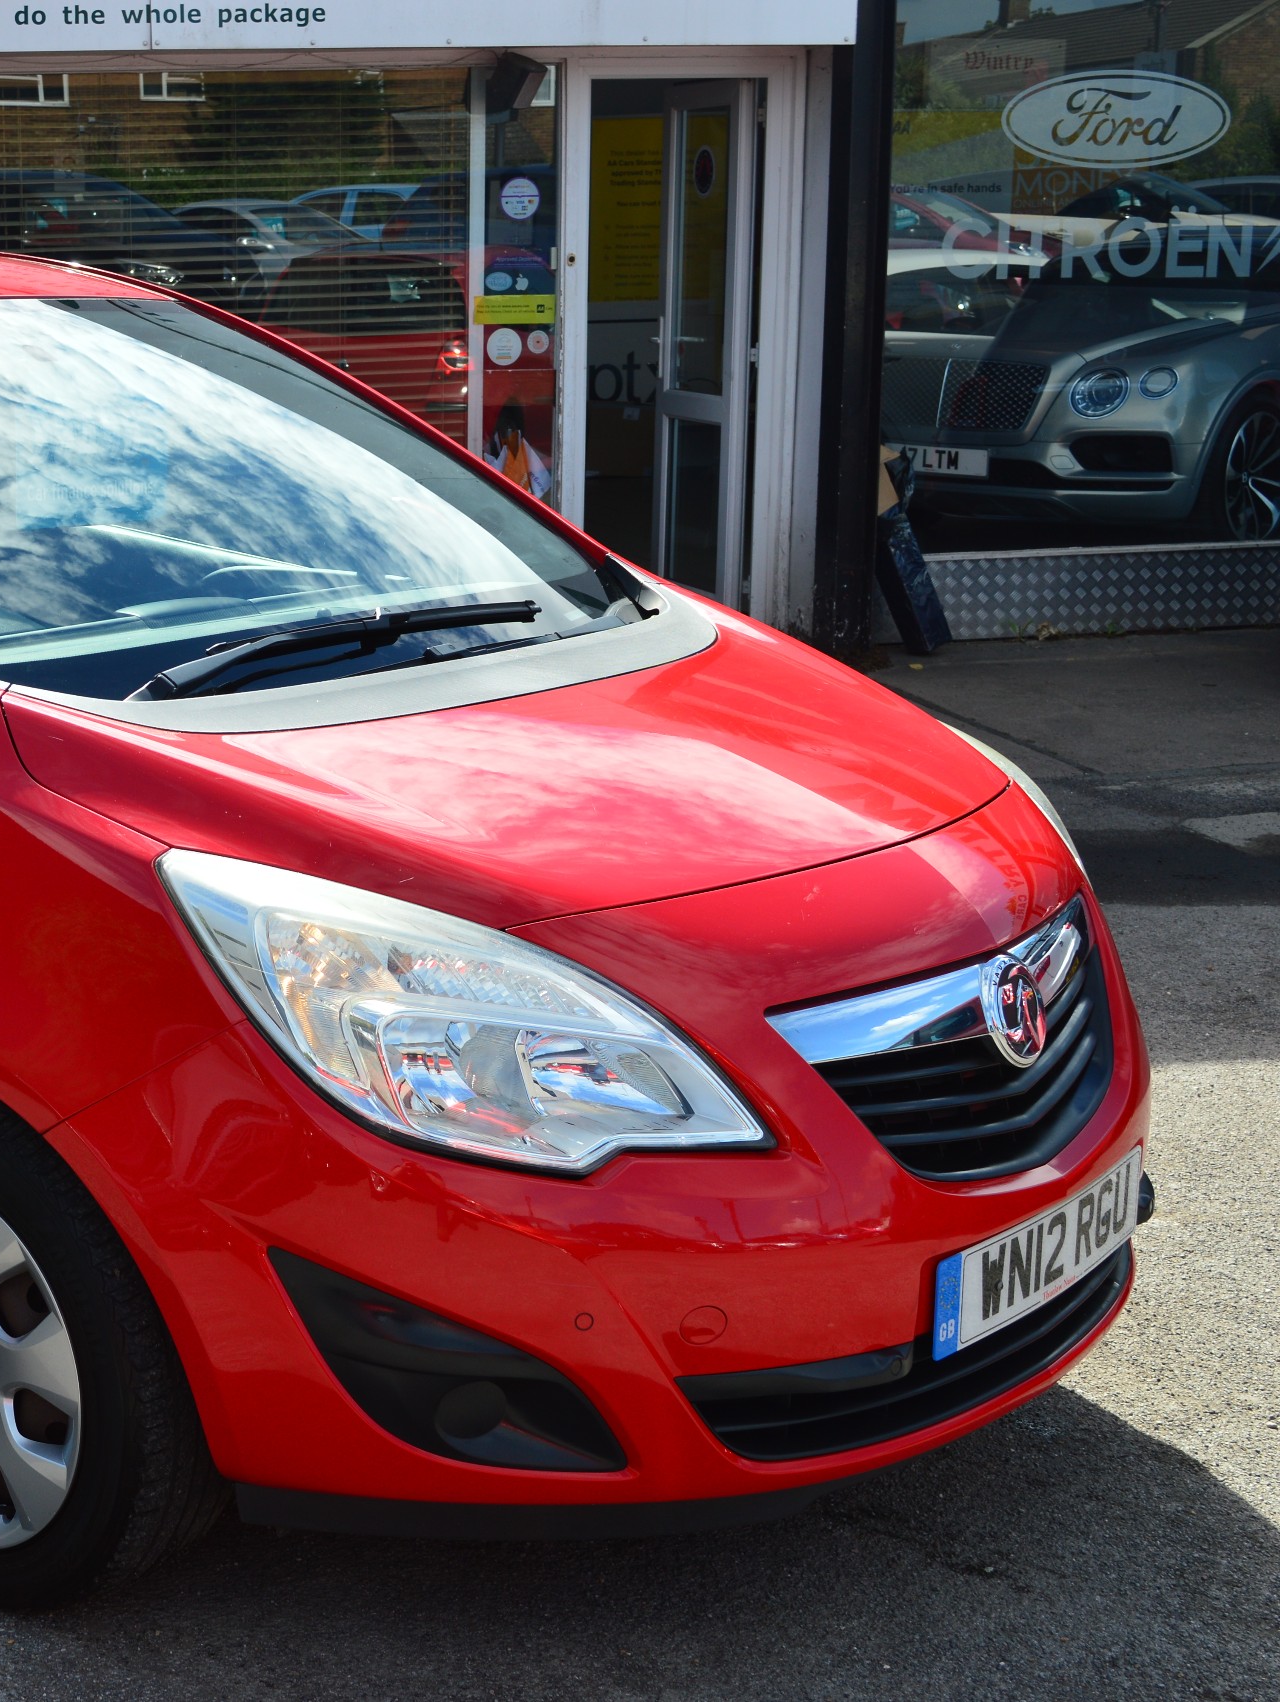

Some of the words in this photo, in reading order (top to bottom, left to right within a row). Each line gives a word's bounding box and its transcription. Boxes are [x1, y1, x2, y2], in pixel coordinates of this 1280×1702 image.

[14, 5, 46, 25] do
[62, 5, 105, 25] the
[121, 4, 202, 24] whole
[218, 3, 326, 28] package
[1051, 87, 1183, 147] Ford
[940, 183, 965, 193] safe
[966, 182, 1002, 193] hands
[941, 205, 1252, 281] CITROËN
[922, 448, 959, 470] LTM
[981, 1211, 1067, 1321] WN12
[1074, 1163, 1131, 1267] RGU
[939, 1318, 955, 1342] GB
